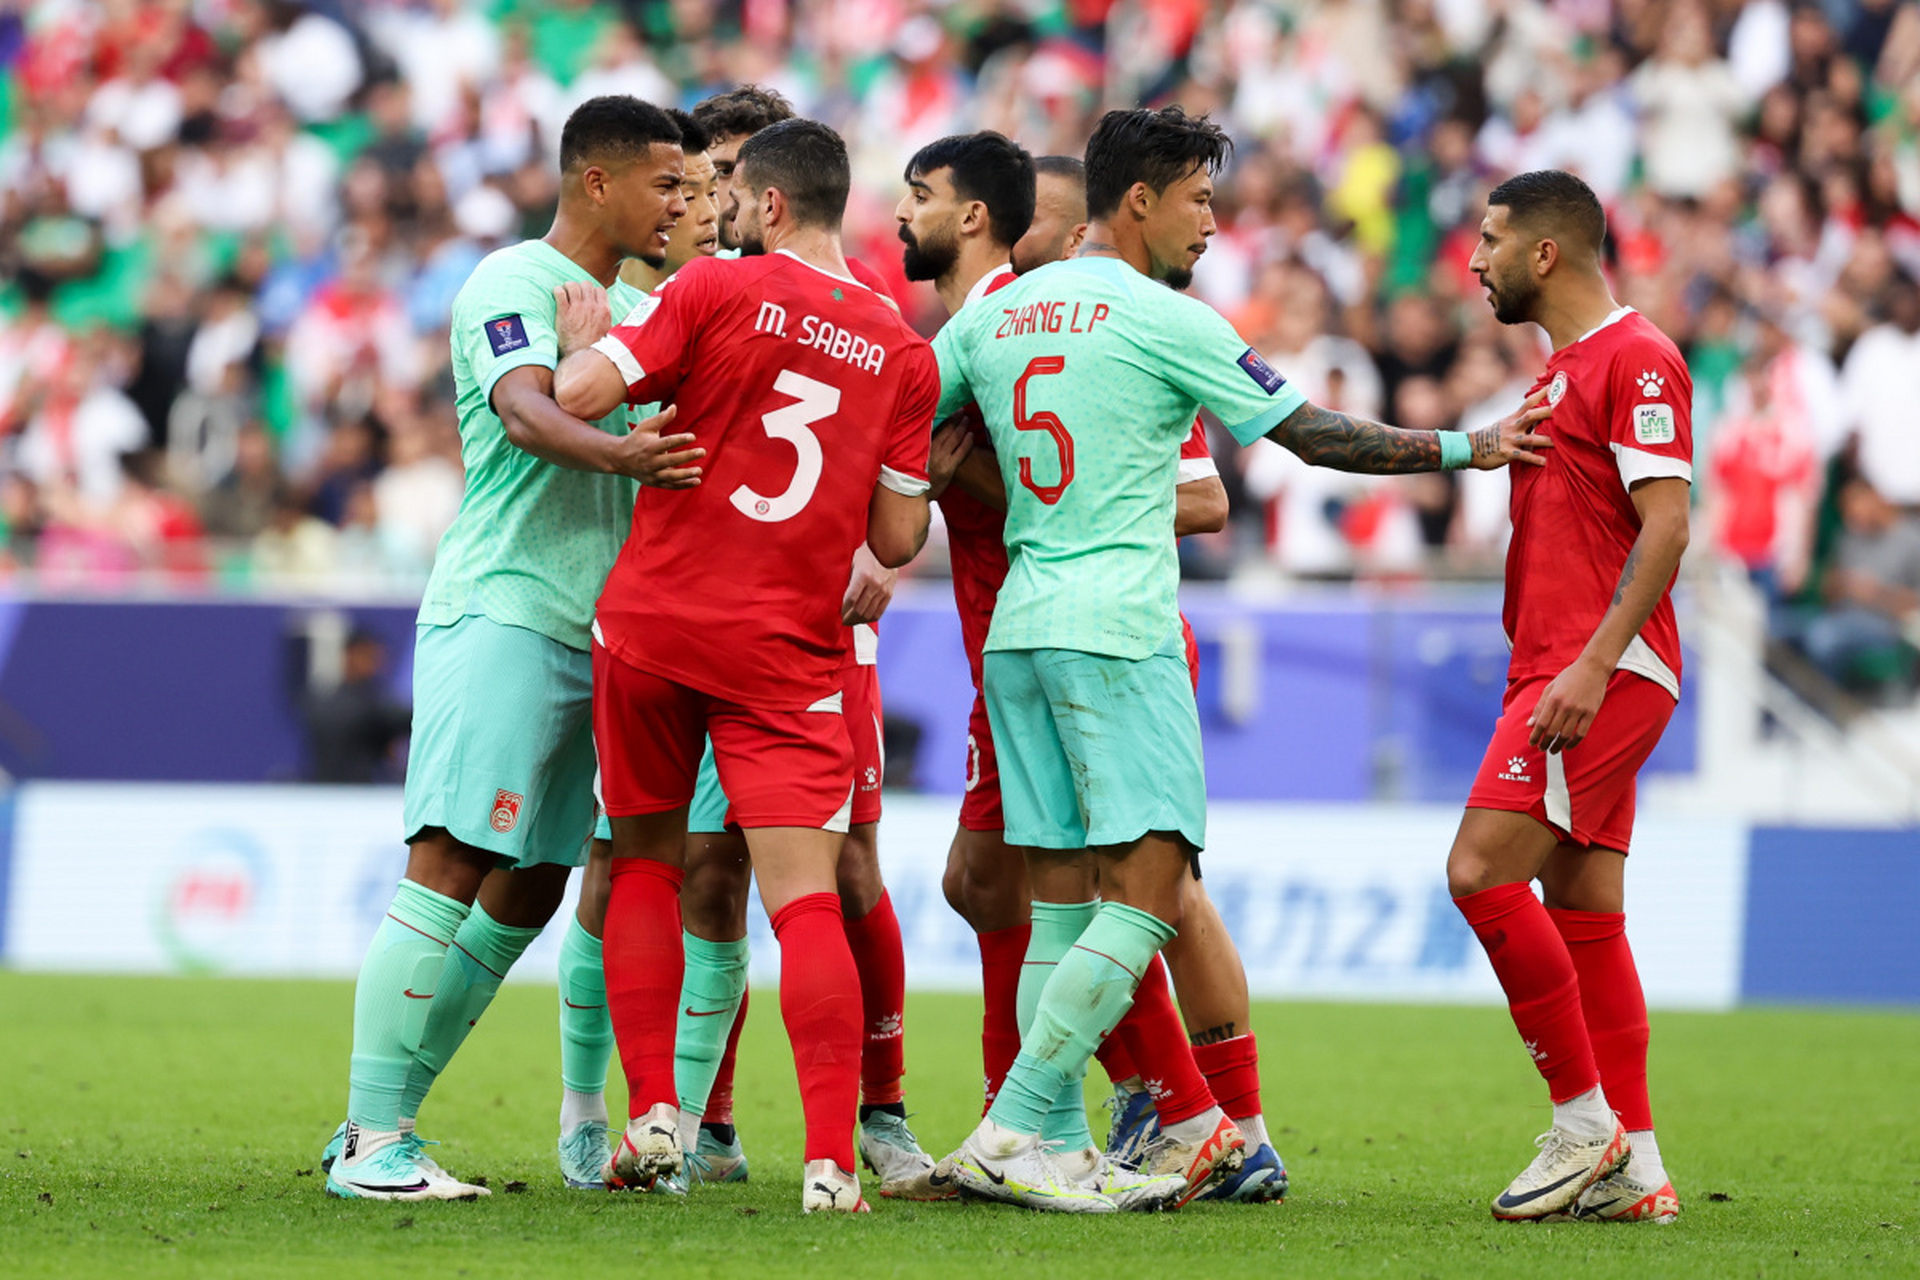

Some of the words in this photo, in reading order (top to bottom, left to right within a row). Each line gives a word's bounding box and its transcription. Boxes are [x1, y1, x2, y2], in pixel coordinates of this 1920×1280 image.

[755, 301, 787, 338] M.
[797, 315, 886, 376] SABRA
[995, 301, 1066, 339] ZHANG
[729, 369, 841, 522] 3
[1013, 355, 1075, 506] 5
[1641, 417, 1668, 428] LIVE
[1497, 772, 1531, 783] KELME
